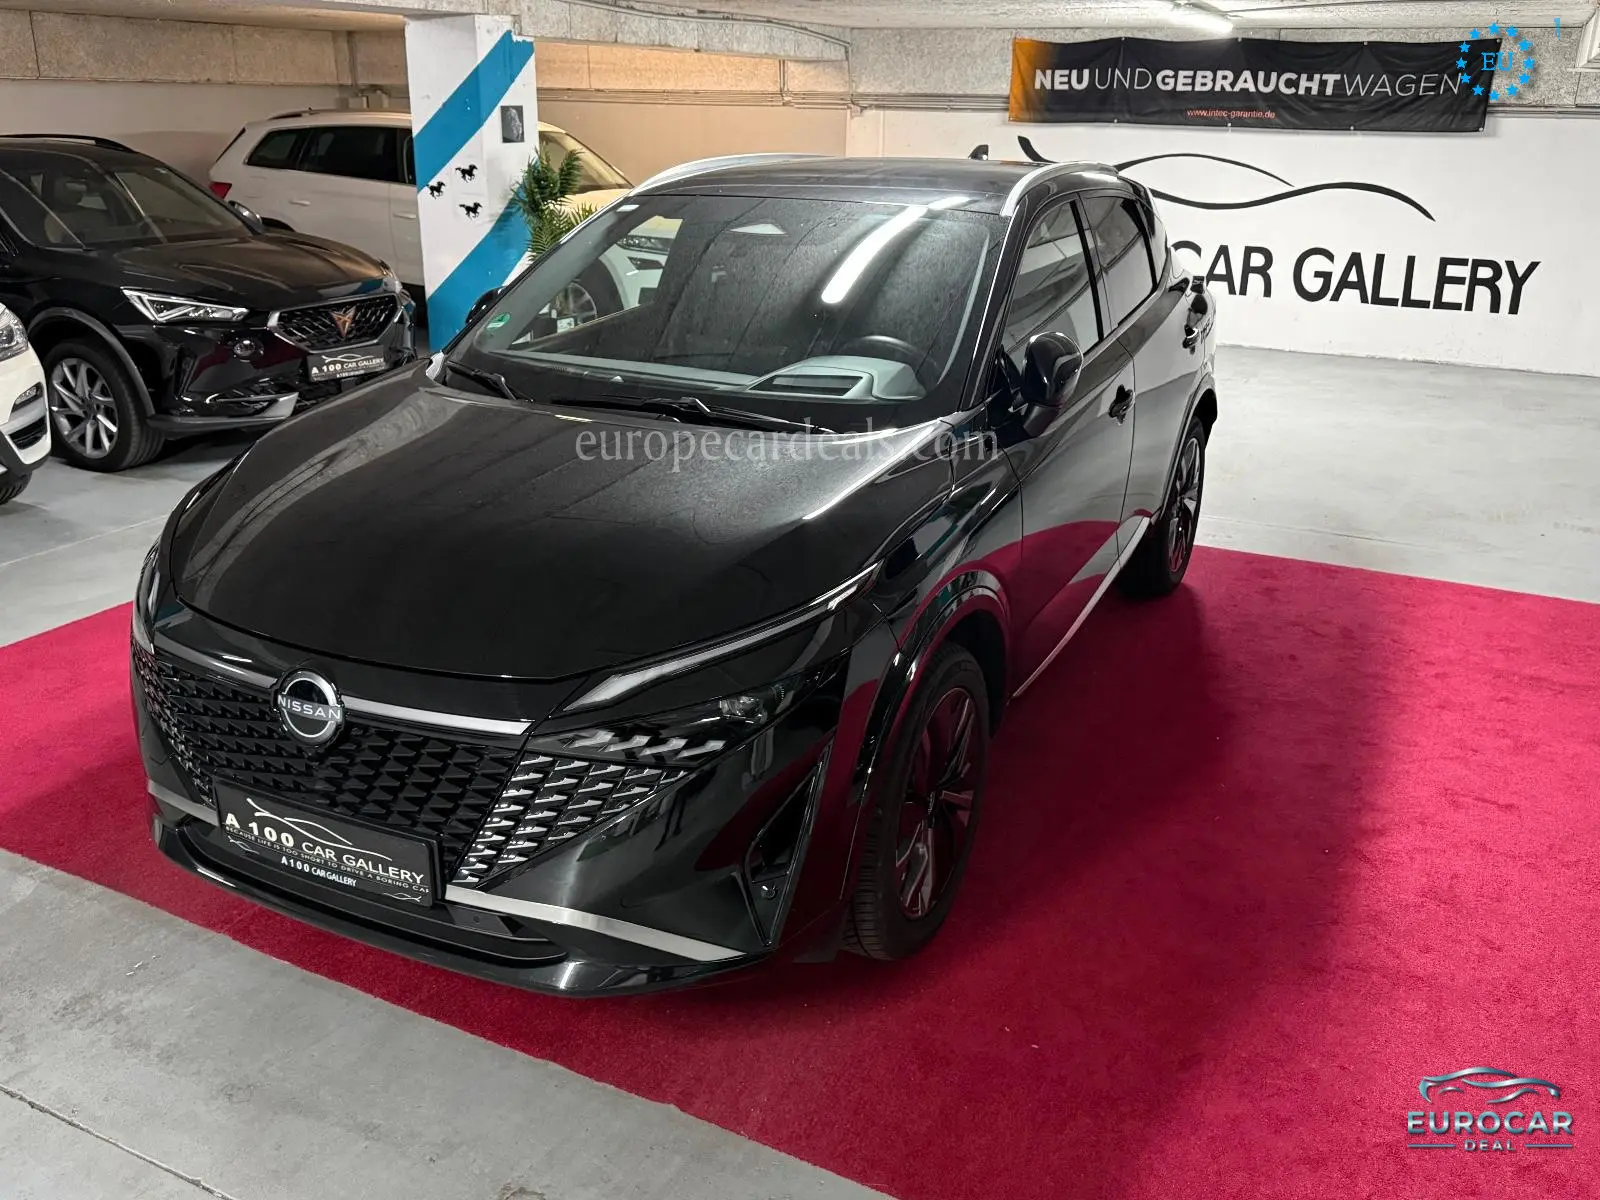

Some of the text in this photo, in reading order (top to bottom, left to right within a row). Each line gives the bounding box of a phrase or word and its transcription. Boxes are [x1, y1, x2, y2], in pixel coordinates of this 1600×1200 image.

[1186, 109, 1276, 119] www.intec-garantie.de
[1292, 247, 1541, 315] GALLERY
[312, 366, 319, 375] A
[322, 363, 342, 373] 100
[358, 357, 384, 367] GALLERY
[277, 694, 341, 720] NISSAN
[225, 812, 424, 884] A 100 CAR GALLERY
[225, 826, 255, 841] BECAUSE
[258, 838, 272, 847] LIFE
[301, 853, 325, 865] SHORT
[341, 865, 364, 876] DRIVE
[376, 875, 409, 888] BORING
[311, 867, 326, 878] CAR
[326, 871, 357, 887] GALLERY
